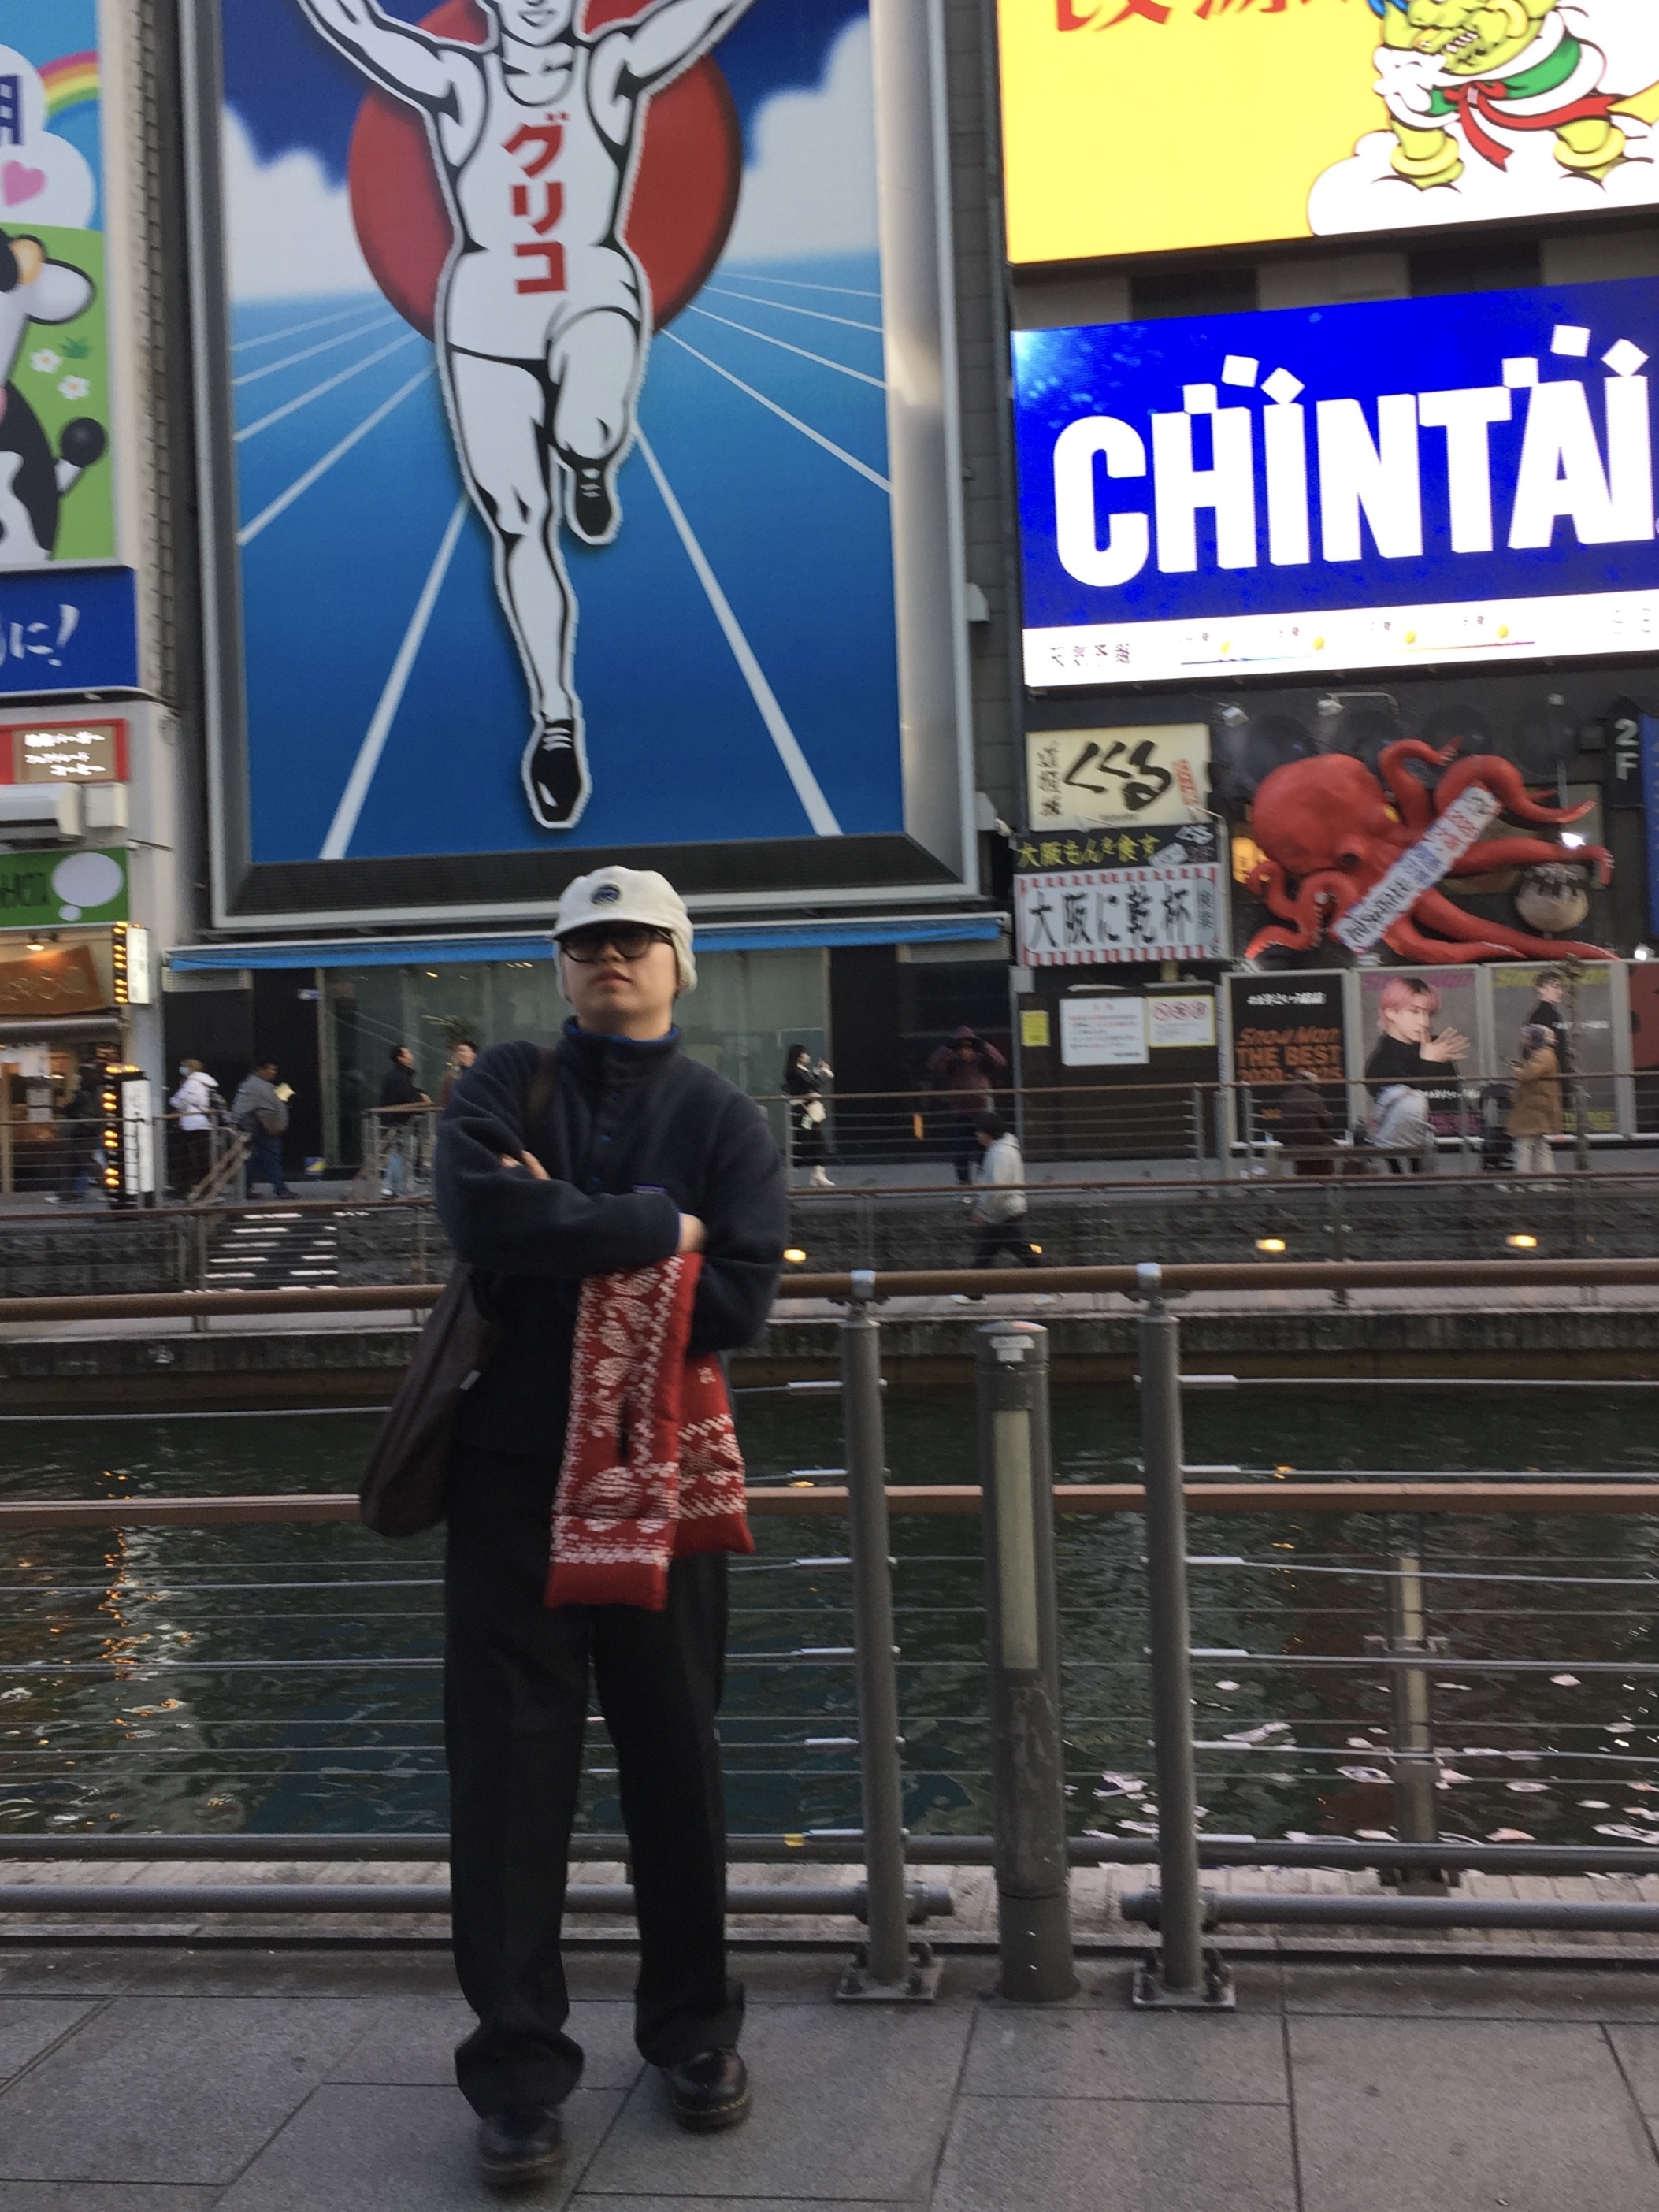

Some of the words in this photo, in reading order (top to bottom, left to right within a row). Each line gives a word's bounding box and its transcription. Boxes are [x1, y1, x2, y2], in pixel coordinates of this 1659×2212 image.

[502, 111, 569, 294] グリコ
[1053, 325, 1655, 588] CHINTAI
[0, 603, 80, 667] に!
[1063, 740, 1172, 810] くくる
[1615, 718, 1639, 780] 2F
[1029, 882, 1192, 948] 大阪に乾杯
[1235, 1046, 1280, 1067] THE
[1284, 1045, 1342, 1066] BEST
